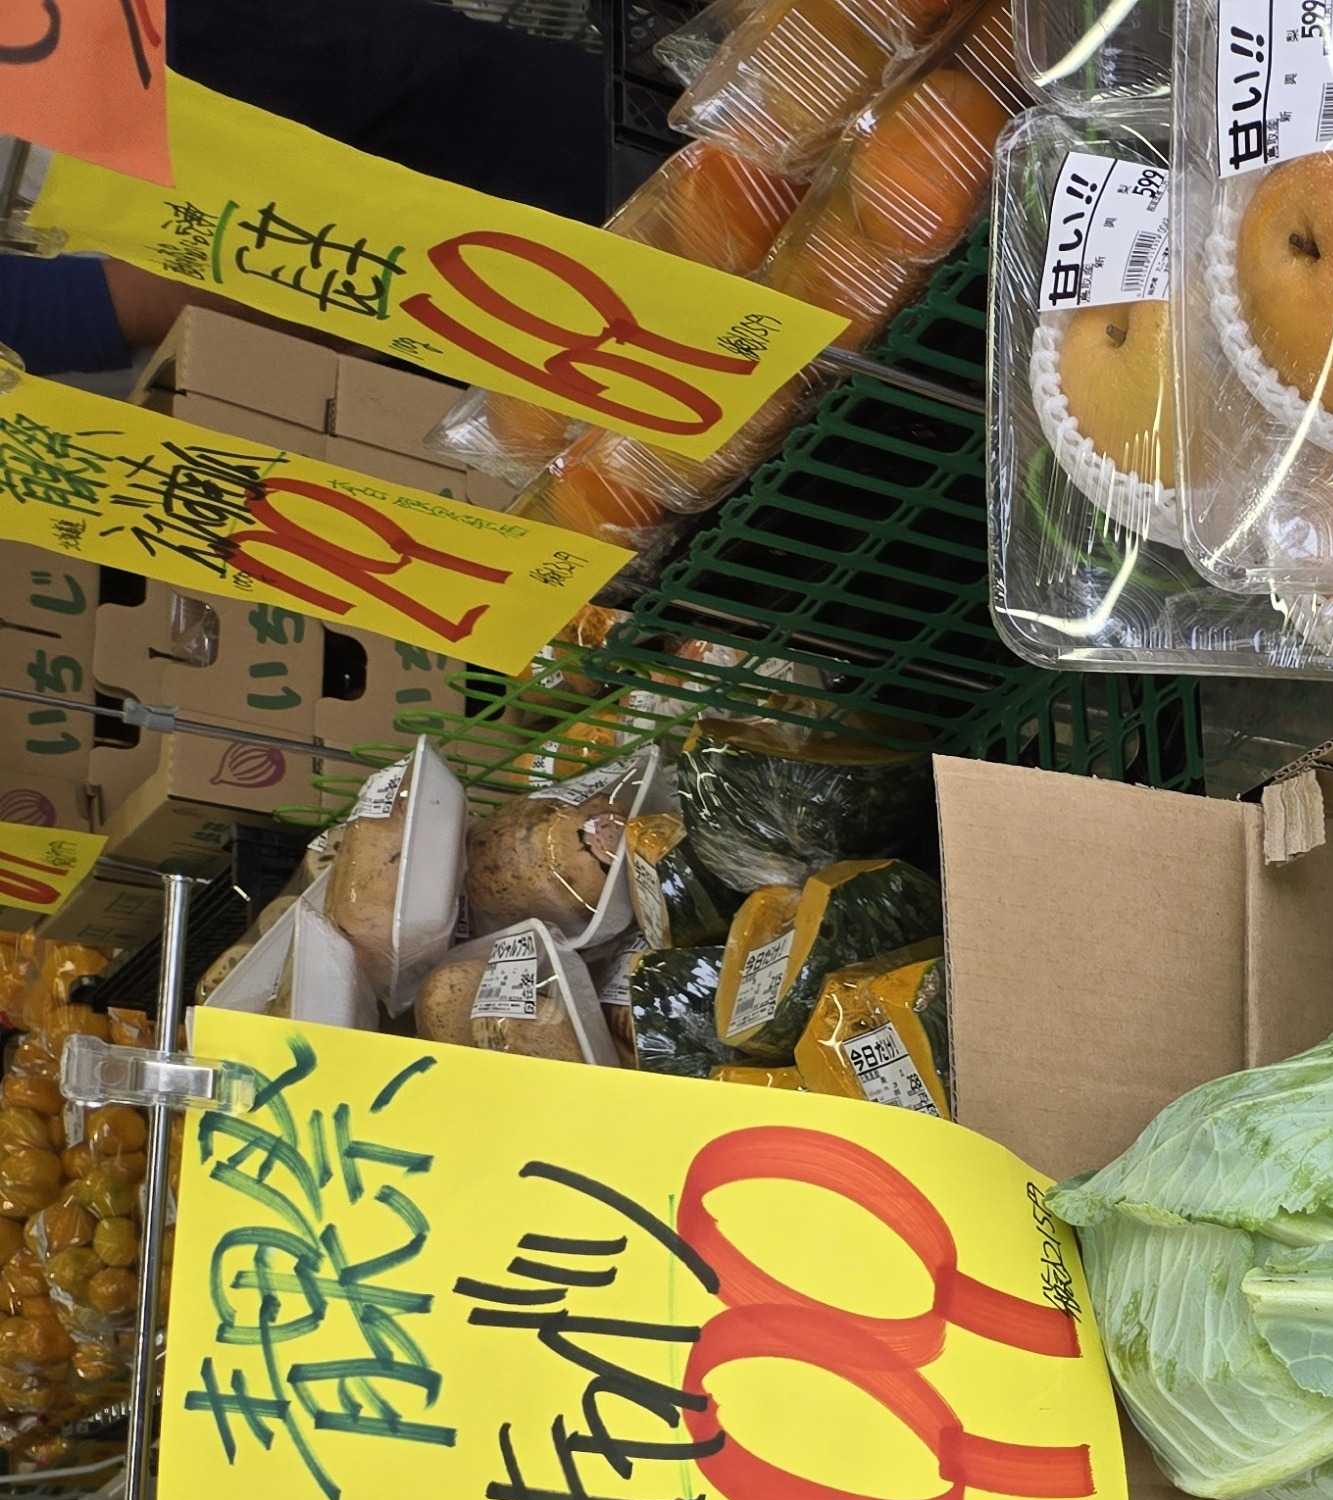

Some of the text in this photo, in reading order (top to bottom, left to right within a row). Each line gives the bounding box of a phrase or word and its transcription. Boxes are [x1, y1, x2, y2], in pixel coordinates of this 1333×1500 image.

[1301, 0, 1325, 38] 599
[1228, 25, 1264, 169] 甘い!!
[1048, 172, 1098, 306] 甘い!!
[1133, 168, 1165, 198] 599
[400, 230, 759, 435] 69
[225, 477, 512, 642] 29
